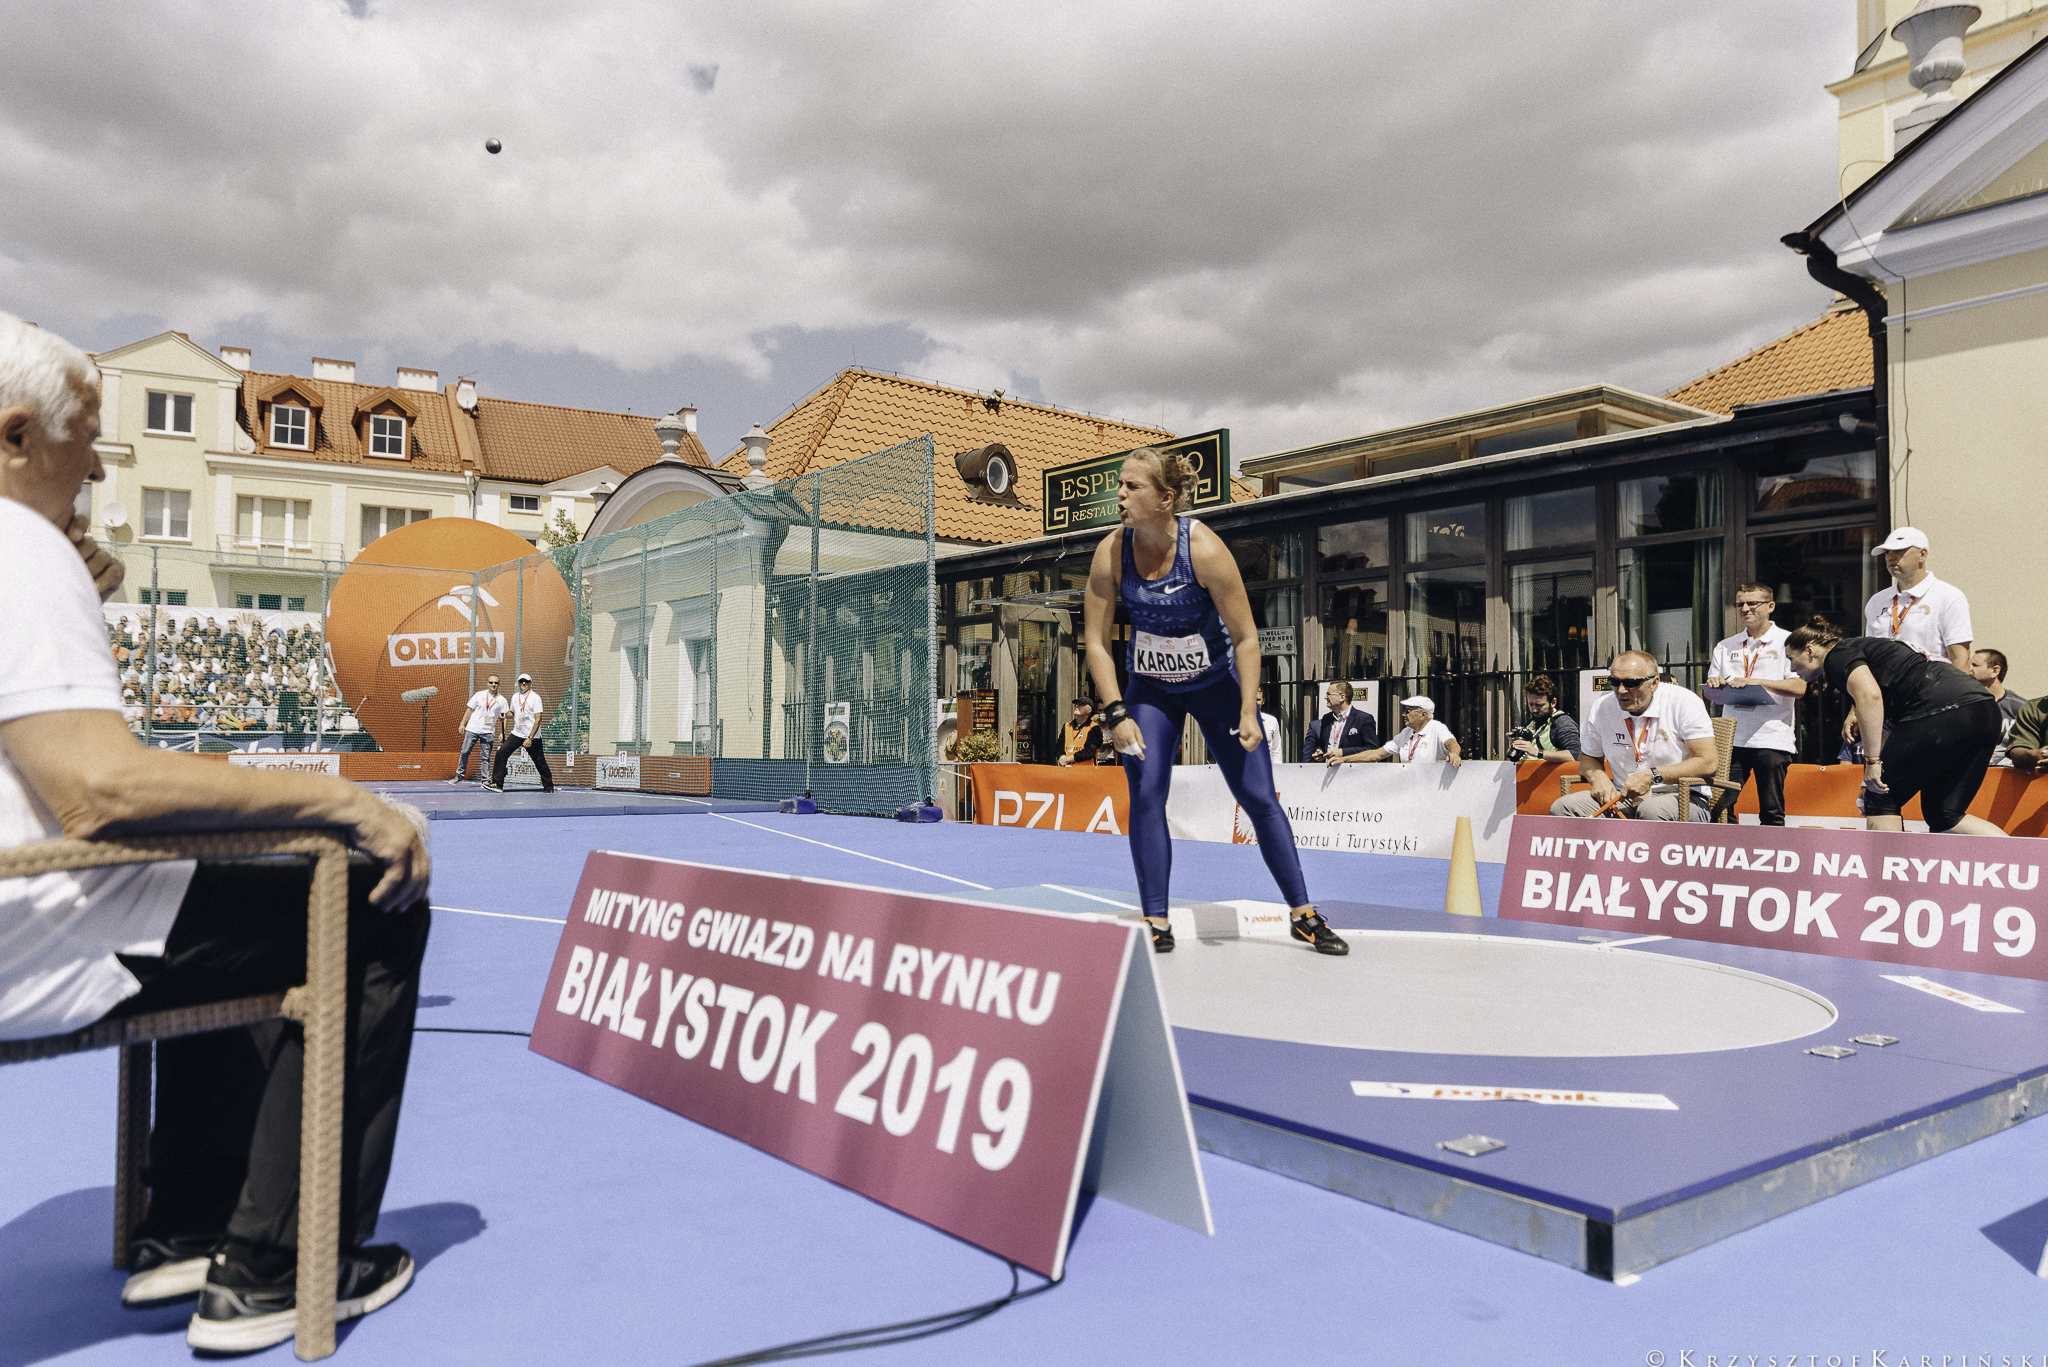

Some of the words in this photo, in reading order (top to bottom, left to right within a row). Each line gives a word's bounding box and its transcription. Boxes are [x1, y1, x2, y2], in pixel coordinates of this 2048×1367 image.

[1072, 505, 1120, 522] RESTAUR
[394, 636, 497, 661] ORLEN
[1137, 648, 1208, 672] KARDASZ
[1287, 806, 1383, 824] Ministerstwo
[1292, 834, 1330, 848] portu
[1335, 833, 1340, 847] i
[1347, 833, 1418, 855] Turystyki
[1529, 836, 1650, 864] MITYNG
[1660, 843, 1800, 874] GWIAZD
[1813, 853, 1868, 879] NA
[1882, 857, 2040, 890] RYNKU
[1252, 914, 1283, 924] polanik
[1521, 869, 1842, 939] BIAŁYSTOK
[1859, 896, 2037, 958] 2019
[584, 888, 686, 942] MITYNG
[687, 907, 815, 971] GWIAZD
[817, 930, 876, 987] NA
[883, 943, 1061, 1026] RYNKU
[556, 945, 838, 1105] BIAŁYSTOK
[834, 1021, 1032, 1172] 2019
